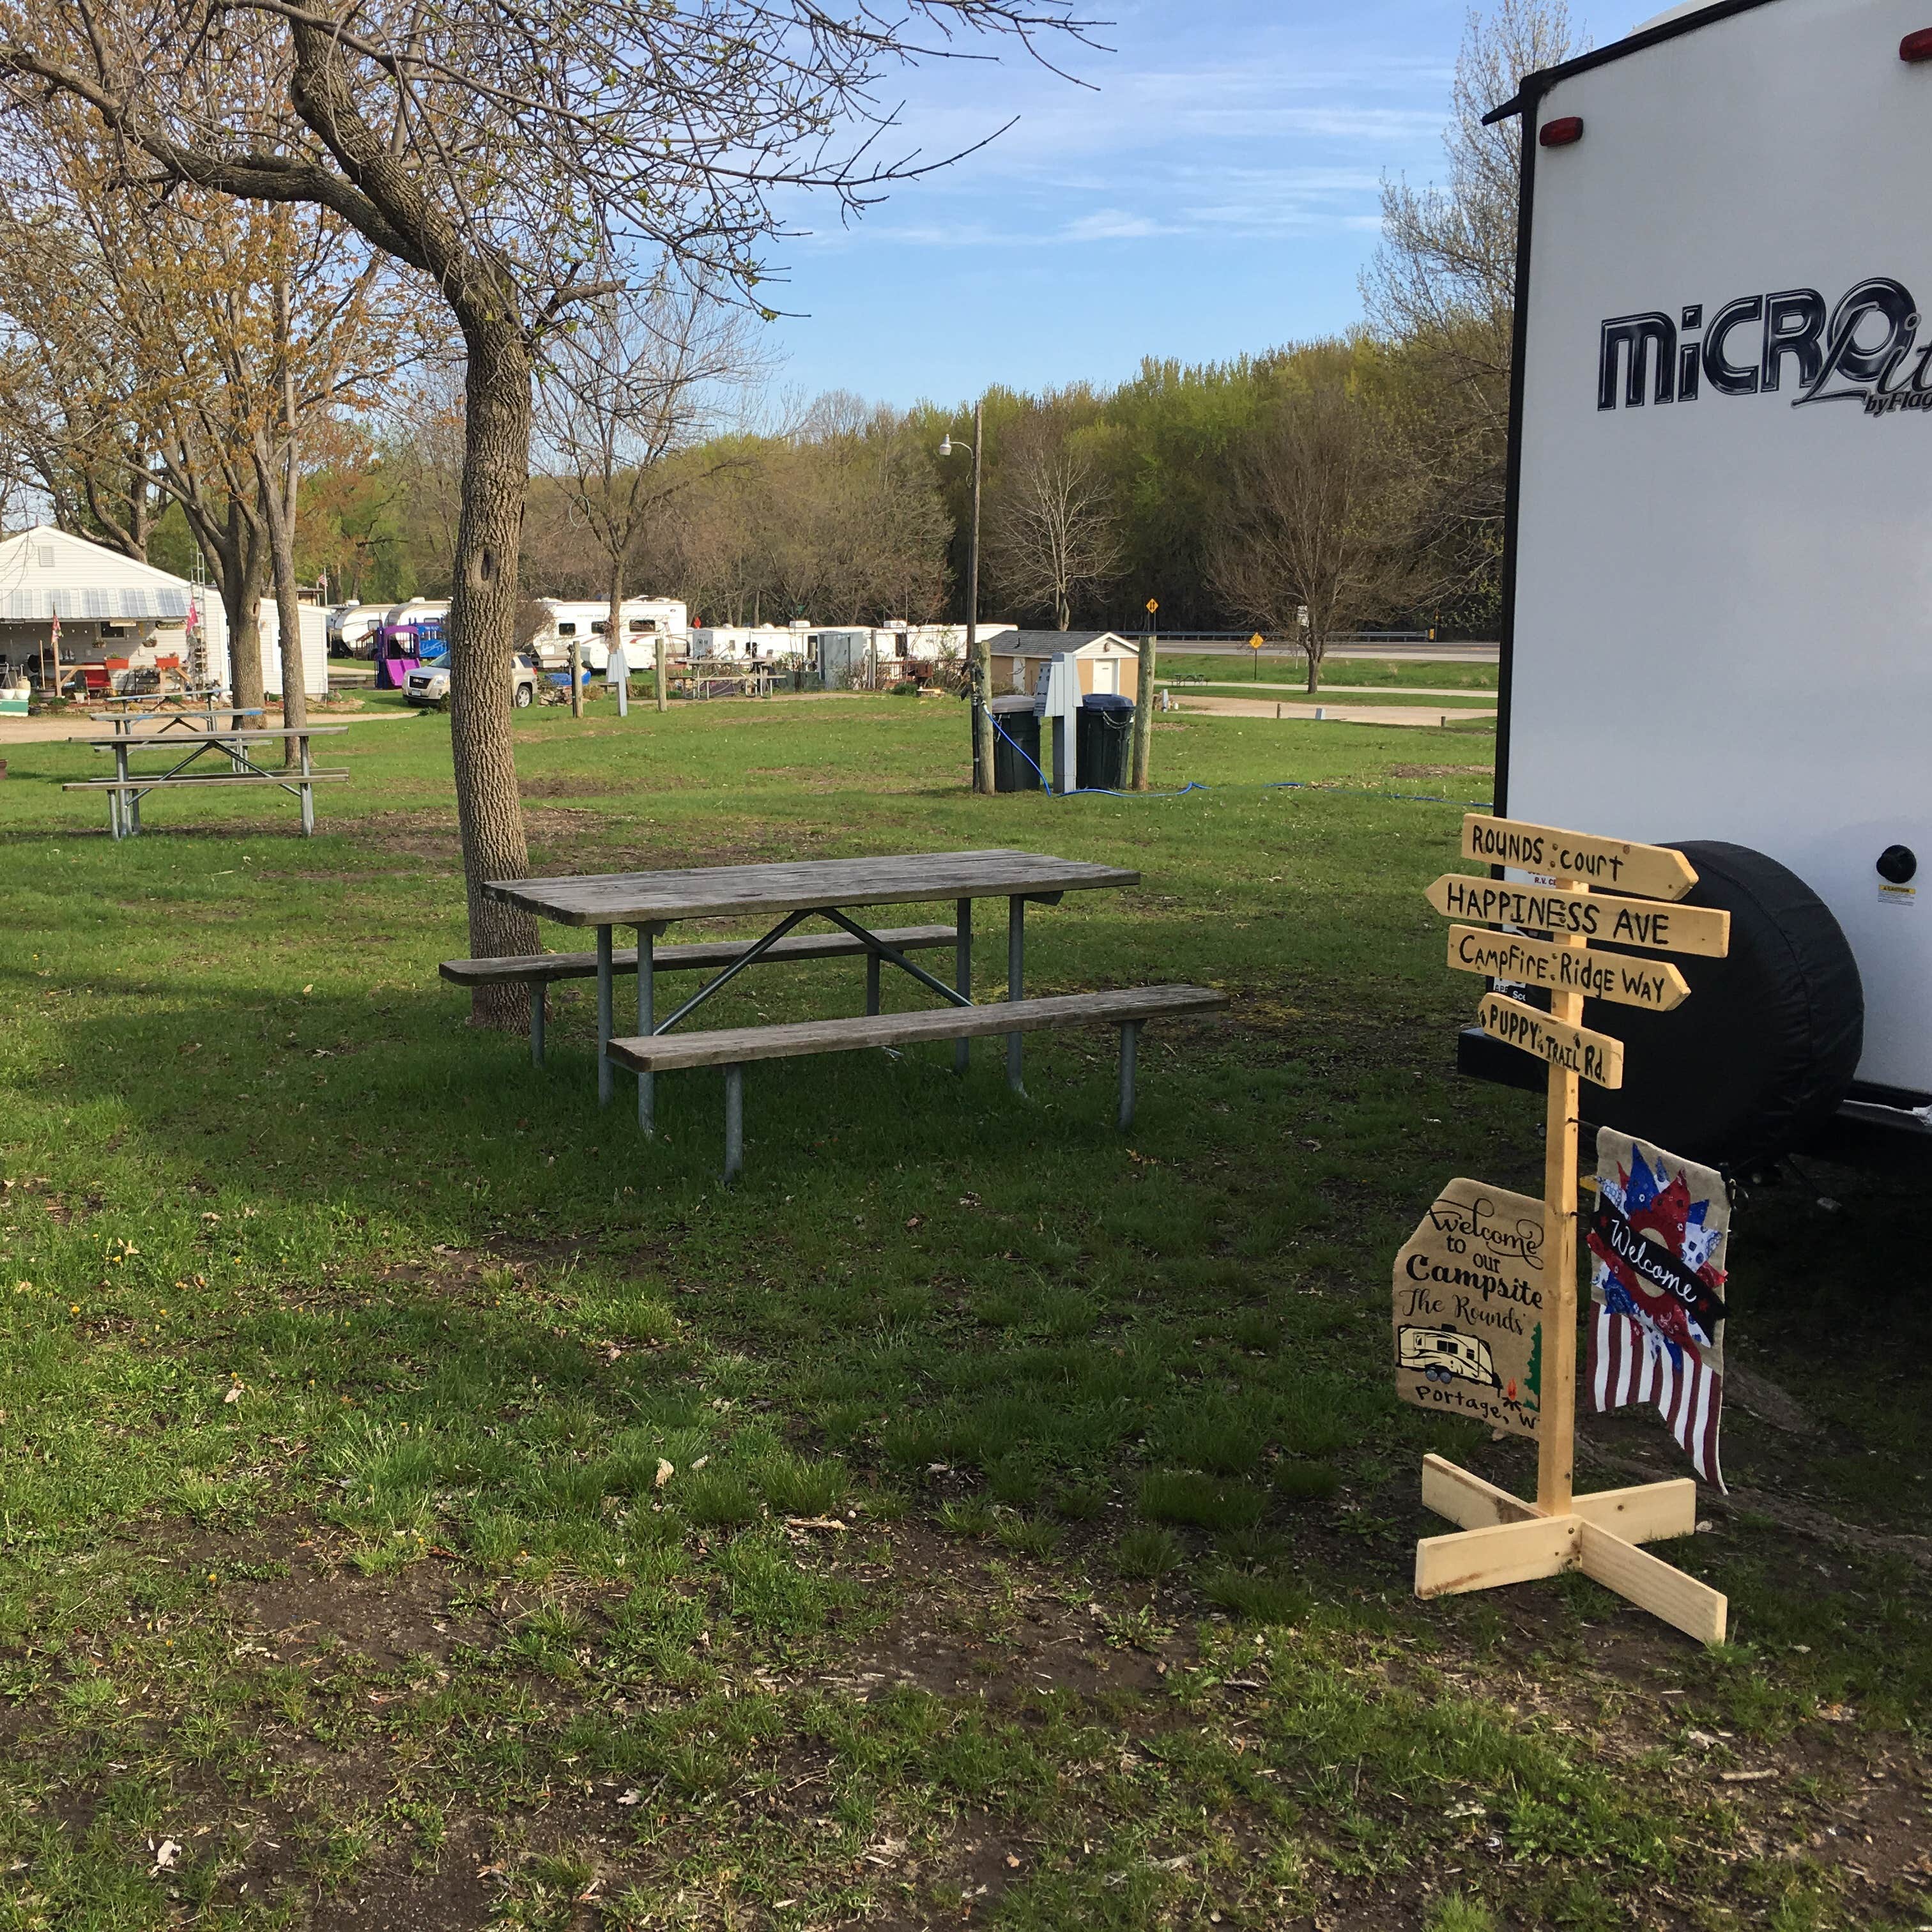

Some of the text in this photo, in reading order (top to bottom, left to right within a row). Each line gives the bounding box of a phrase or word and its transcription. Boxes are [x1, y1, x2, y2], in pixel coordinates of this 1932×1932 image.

[1473, 825, 1544, 864] ROUNDS
[1447, 882, 1669, 945] HAPPINESS AVE
[1489, 1004, 1606, 1082] PUPPY TRAIL Rd.
[1427, 1198, 1544, 1269] Welcome
[1446, 1234, 1466, 1254] to
[1406, 1254, 1543, 1309] Campsite
[1473, 1252, 1501, 1274] our
[1611, 1218, 1697, 1303] Welcome
[1399, 1288, 1445, 1316] The
[1519, 1413, 1540, 1430] W
